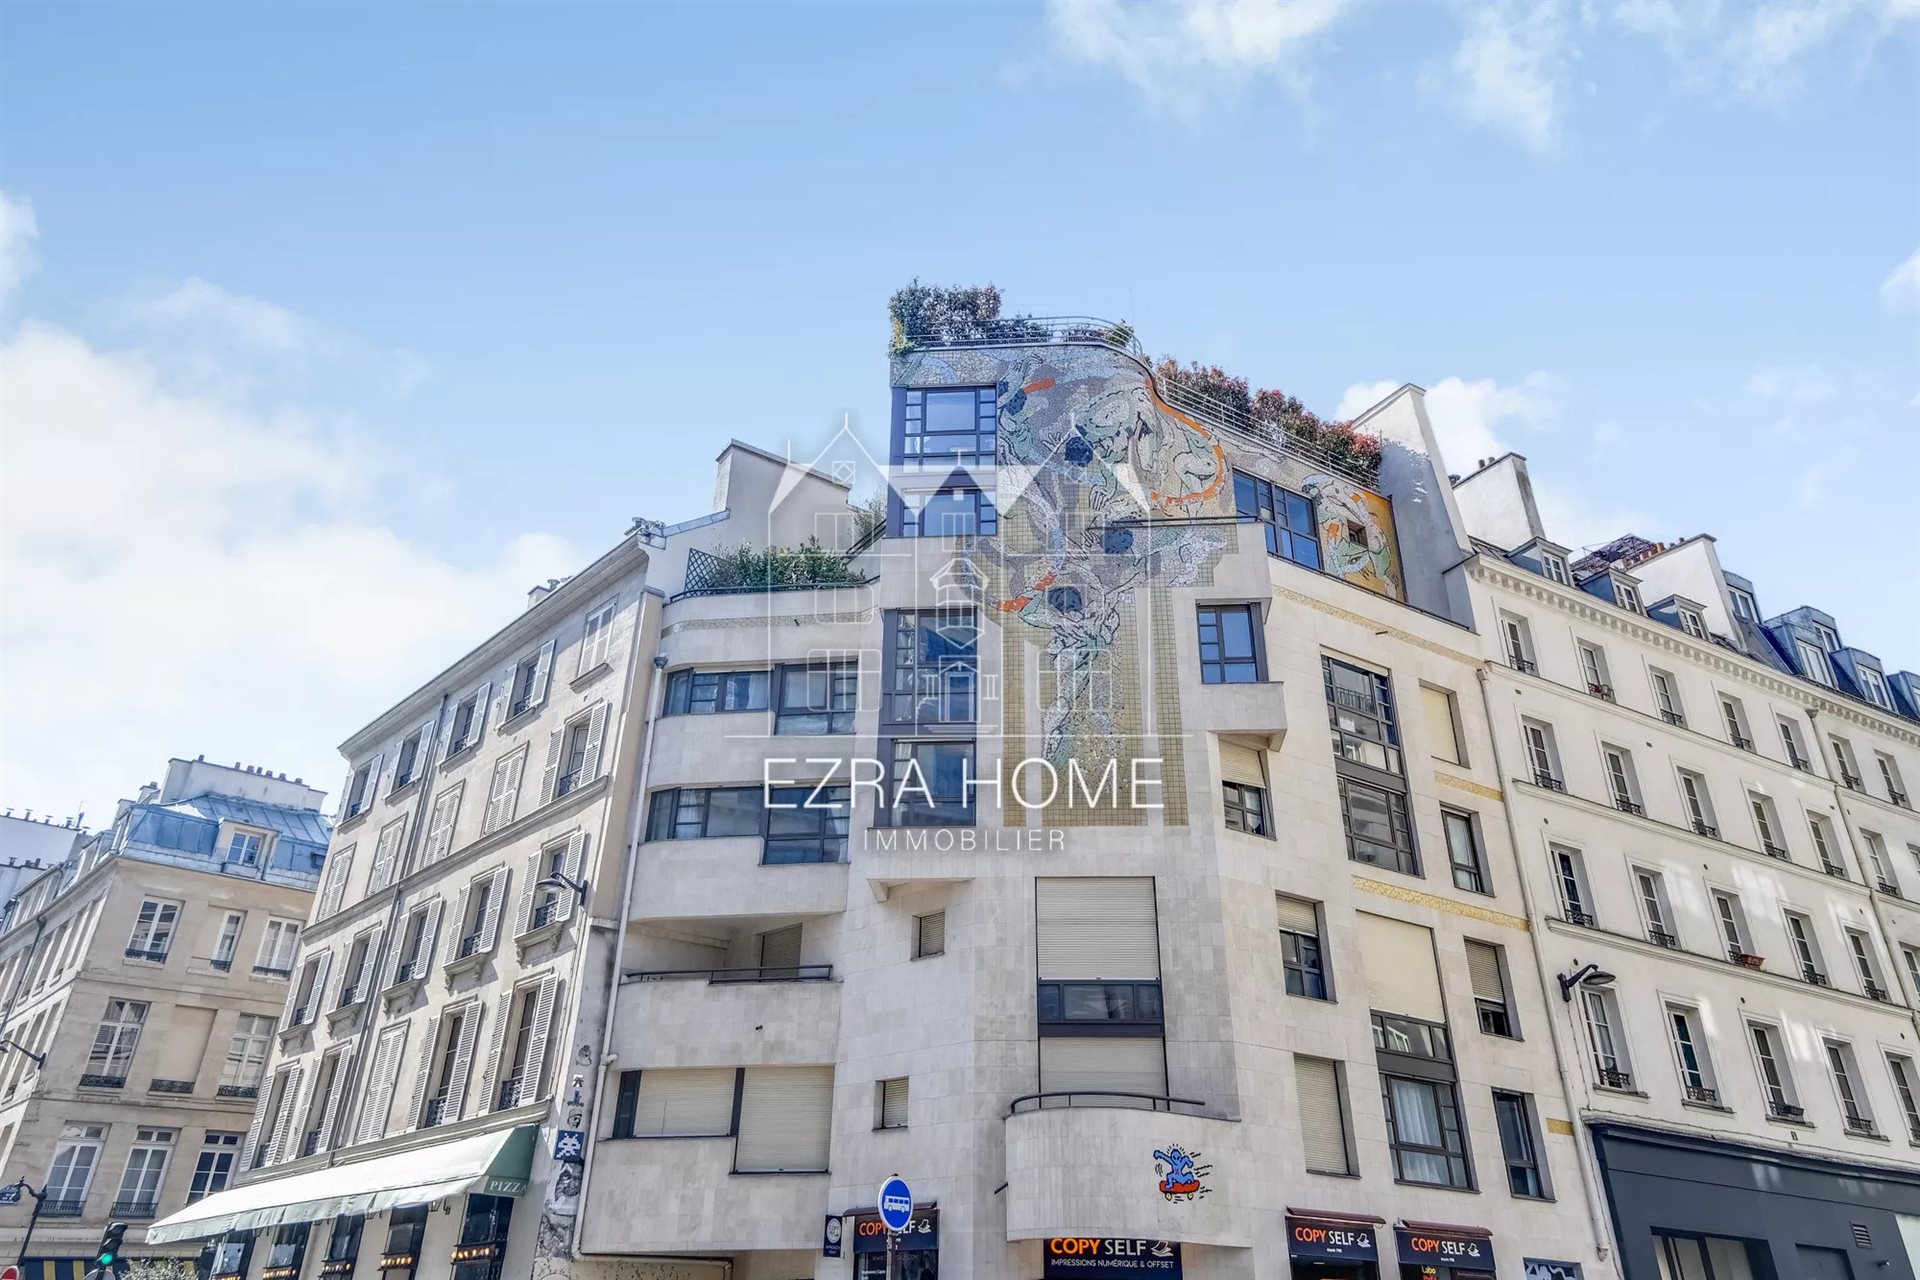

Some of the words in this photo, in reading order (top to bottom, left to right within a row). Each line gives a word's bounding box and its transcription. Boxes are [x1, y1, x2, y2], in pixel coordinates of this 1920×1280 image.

[1295, 1227, 1327, 1243] COPY
[1328, 1230, 1354, 1246] SELF
[1050, 1238, 1101, 1255] COPY
[1104, 1239, 1146, 1256] SELF
[1411, 1237, 1440, 1253] COPY
[1441, 1241, 1465, 1255] SELF
[1051, 1259, 1096, 1267] IMPRESSIONS
[1098, 1258, 1138, 1268] NUMÉRIQUE
[1146, 1261, 1174, 1269] OFFSET
